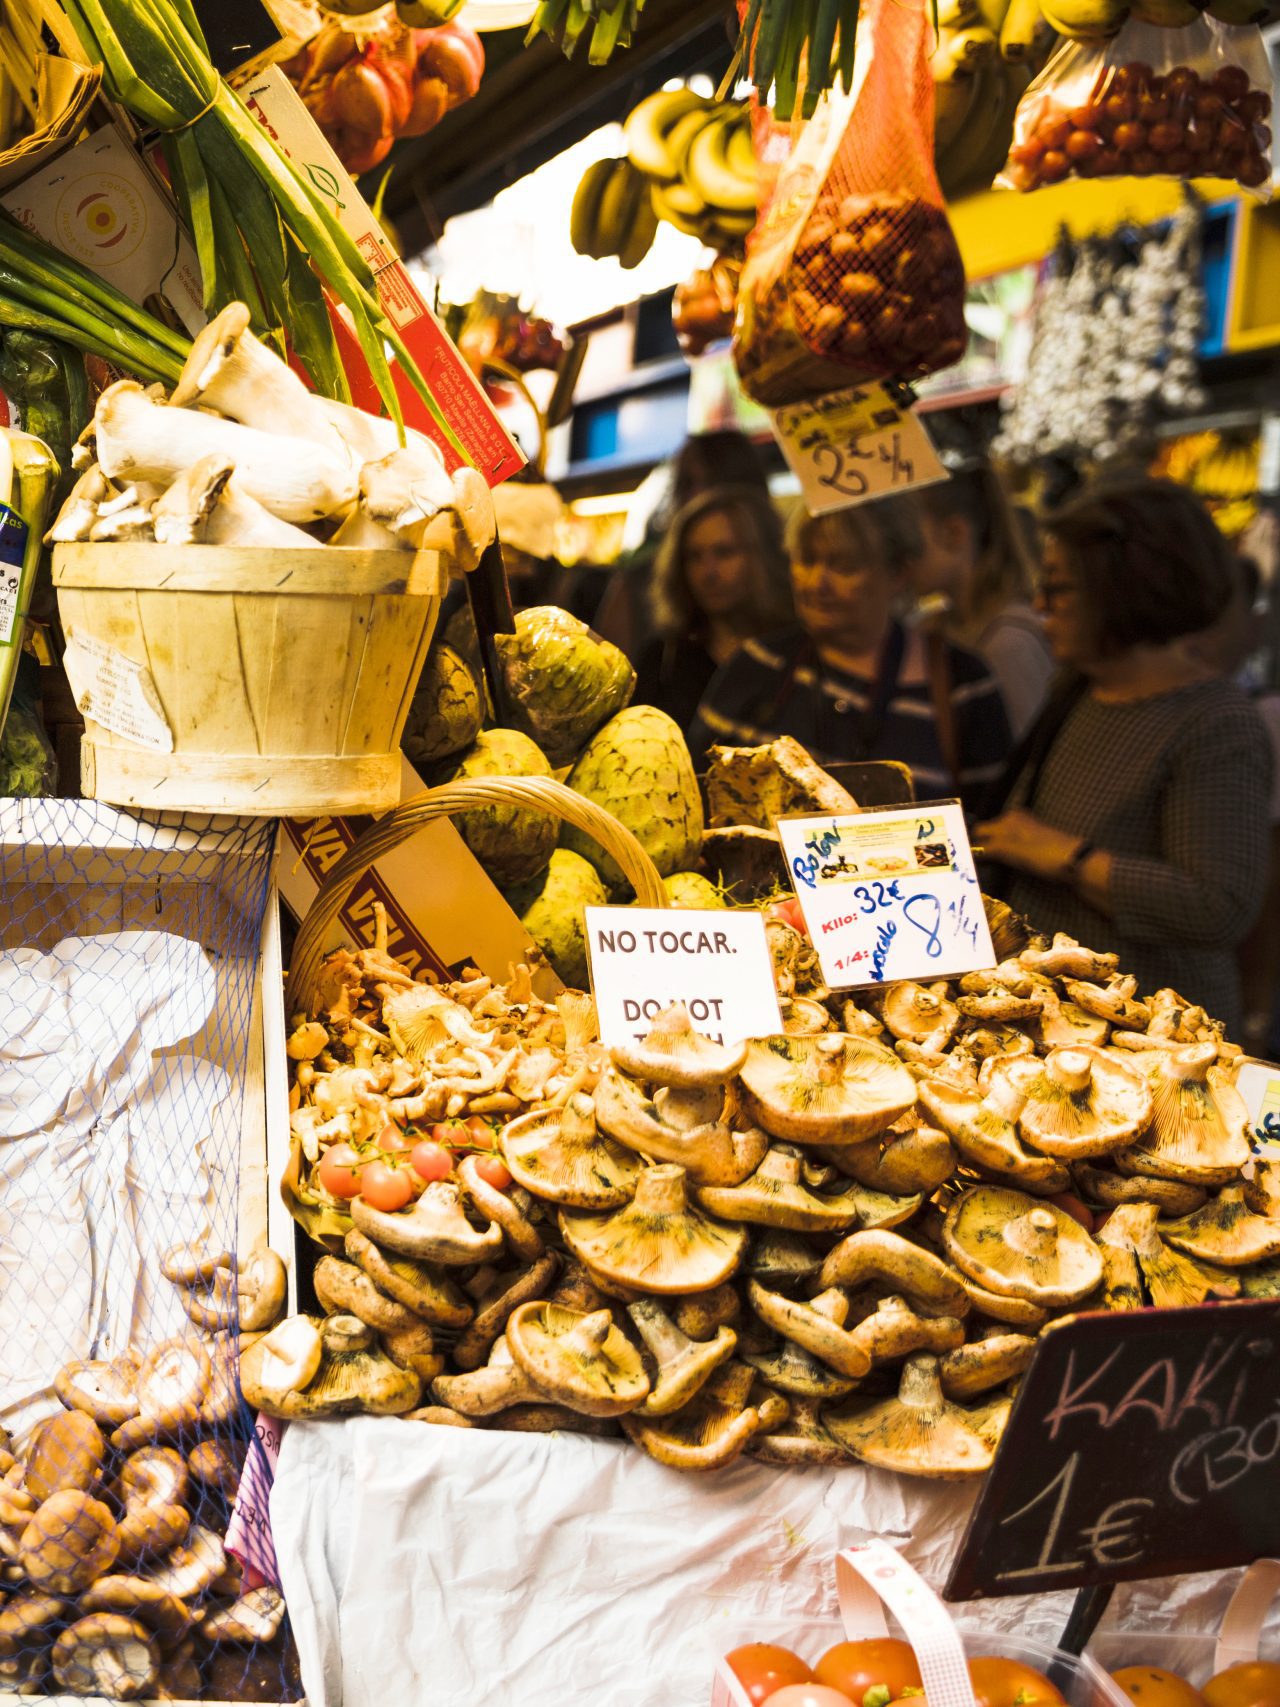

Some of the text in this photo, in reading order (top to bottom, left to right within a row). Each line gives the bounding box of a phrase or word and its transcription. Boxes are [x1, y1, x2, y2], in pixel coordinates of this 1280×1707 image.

[821, 912, 858, 935] Kilo:
[903, 893, 942, 958] 8
[598, 930, 738, 954] NO TOCAR.
[834, 950, 870, 971] 1/4:
[623, 998, 723, 1021] DO OT
